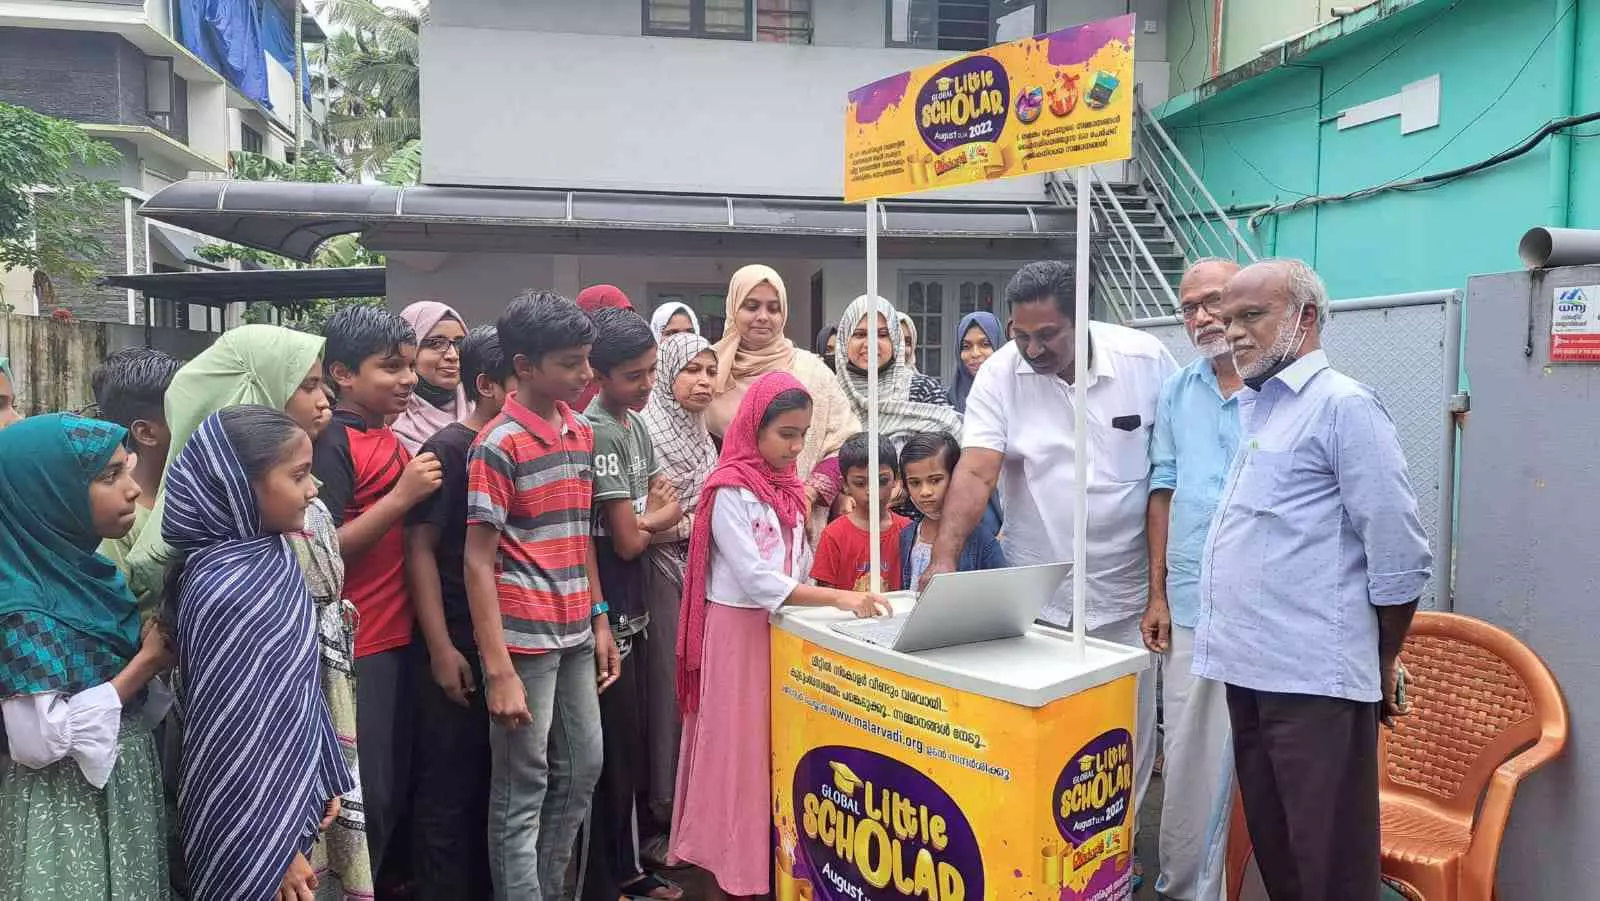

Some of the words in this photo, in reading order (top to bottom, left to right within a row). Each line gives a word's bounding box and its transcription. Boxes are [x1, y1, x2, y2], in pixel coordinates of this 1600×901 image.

[922, 90, 1004, 128] SCHOLAR
[931, 90, 953, 101] GLOBAL
[934, 130, 957, 142] August
[968, 120, 993, 138] 2022
[594, 453, 619, 476] 98
[830, 706, 923, 753] www.malarvadi.org
[1060, 763, 1131, 819] SCHOLAR
[1072, 769, 1095, 785] GLOBAL
[821, 784, 861, 815] GLOBAL
[1073, 815, 1096, 832] August
[1105, 797, 1124, 821] 2022
[821, 862, 864, 901] August
